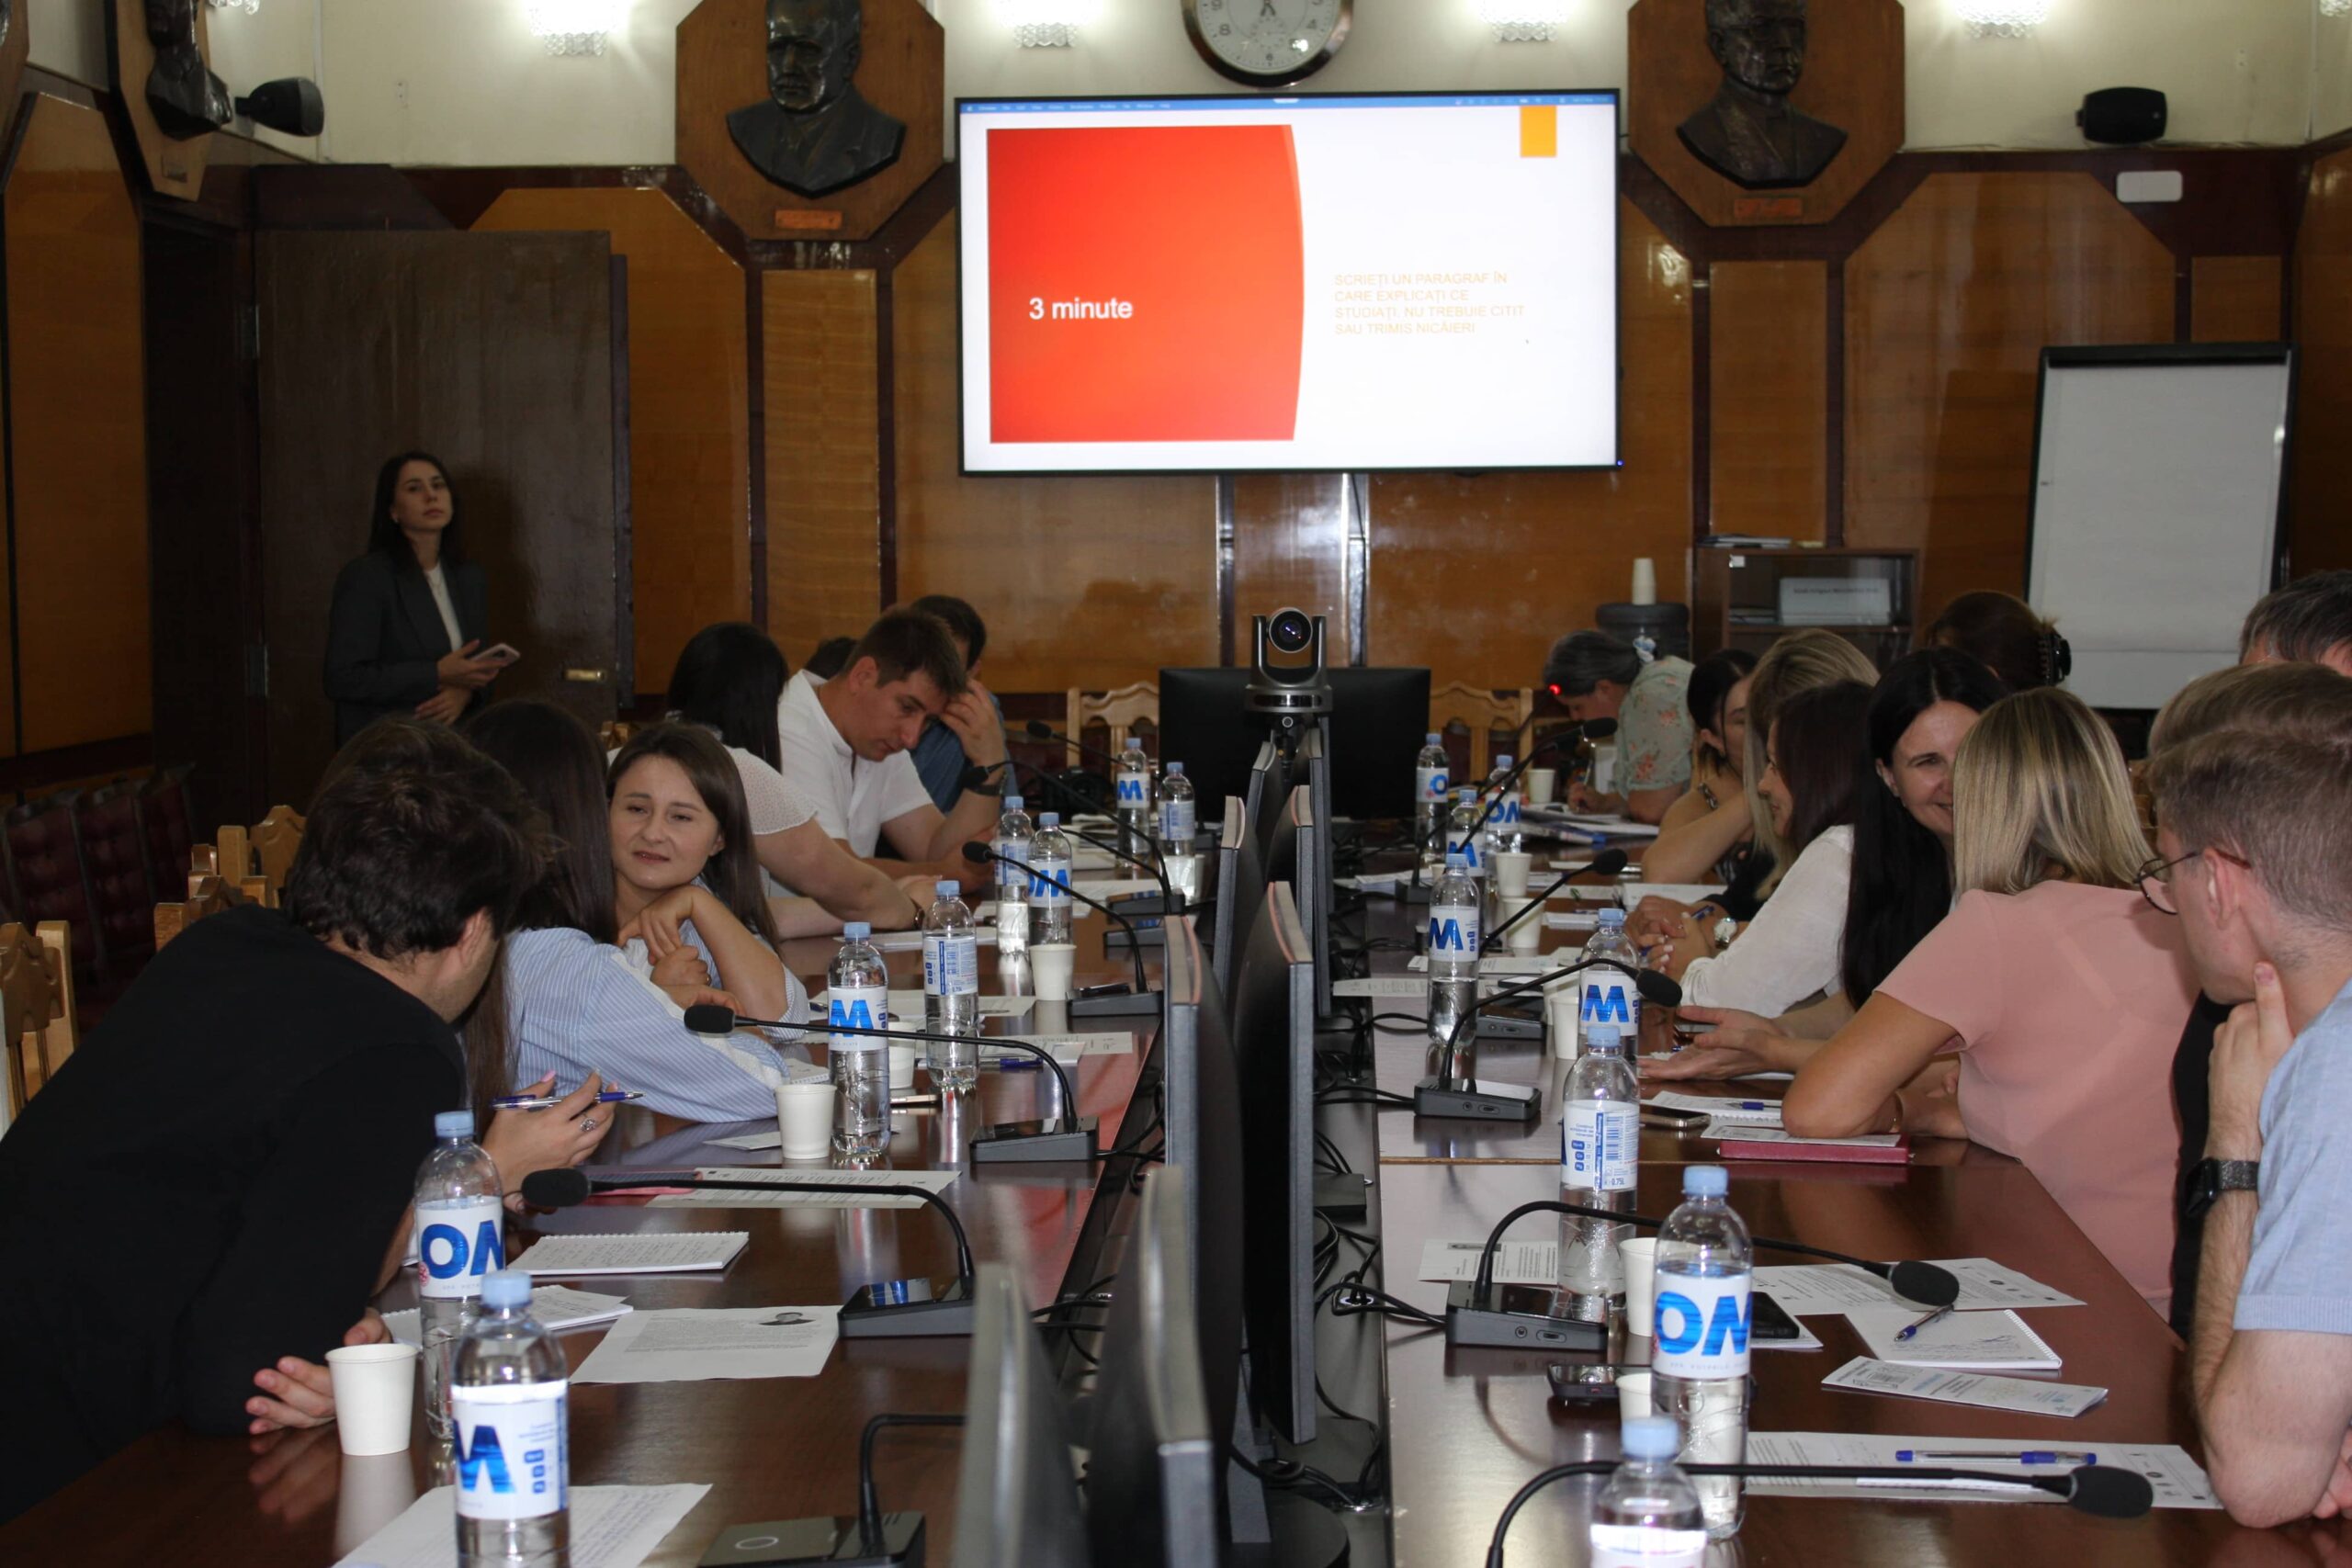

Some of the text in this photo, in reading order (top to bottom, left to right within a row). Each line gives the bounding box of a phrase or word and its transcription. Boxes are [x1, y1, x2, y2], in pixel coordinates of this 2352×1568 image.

[1219, 24, 1231, 36] 8
[1393, 274, 1412, 285] UN
[1416, 272, 1489, 285] PARAGRAF
[1335, 290, 1373, 302] CARE
[1450, 289, 1469, 301] CE
[1029, 296, 1133, 320] 3 minute
[1404, 306, 1424, 317] NU
[1428, 305, 1487, 317] TREBUIE
[1490, 305, 1525, 317] CITIT
[1335, 322, 1362, 334] SAU
[1366, 322, 1413, 334] TRIMIS
[1428, 917, 1464, 951] M
